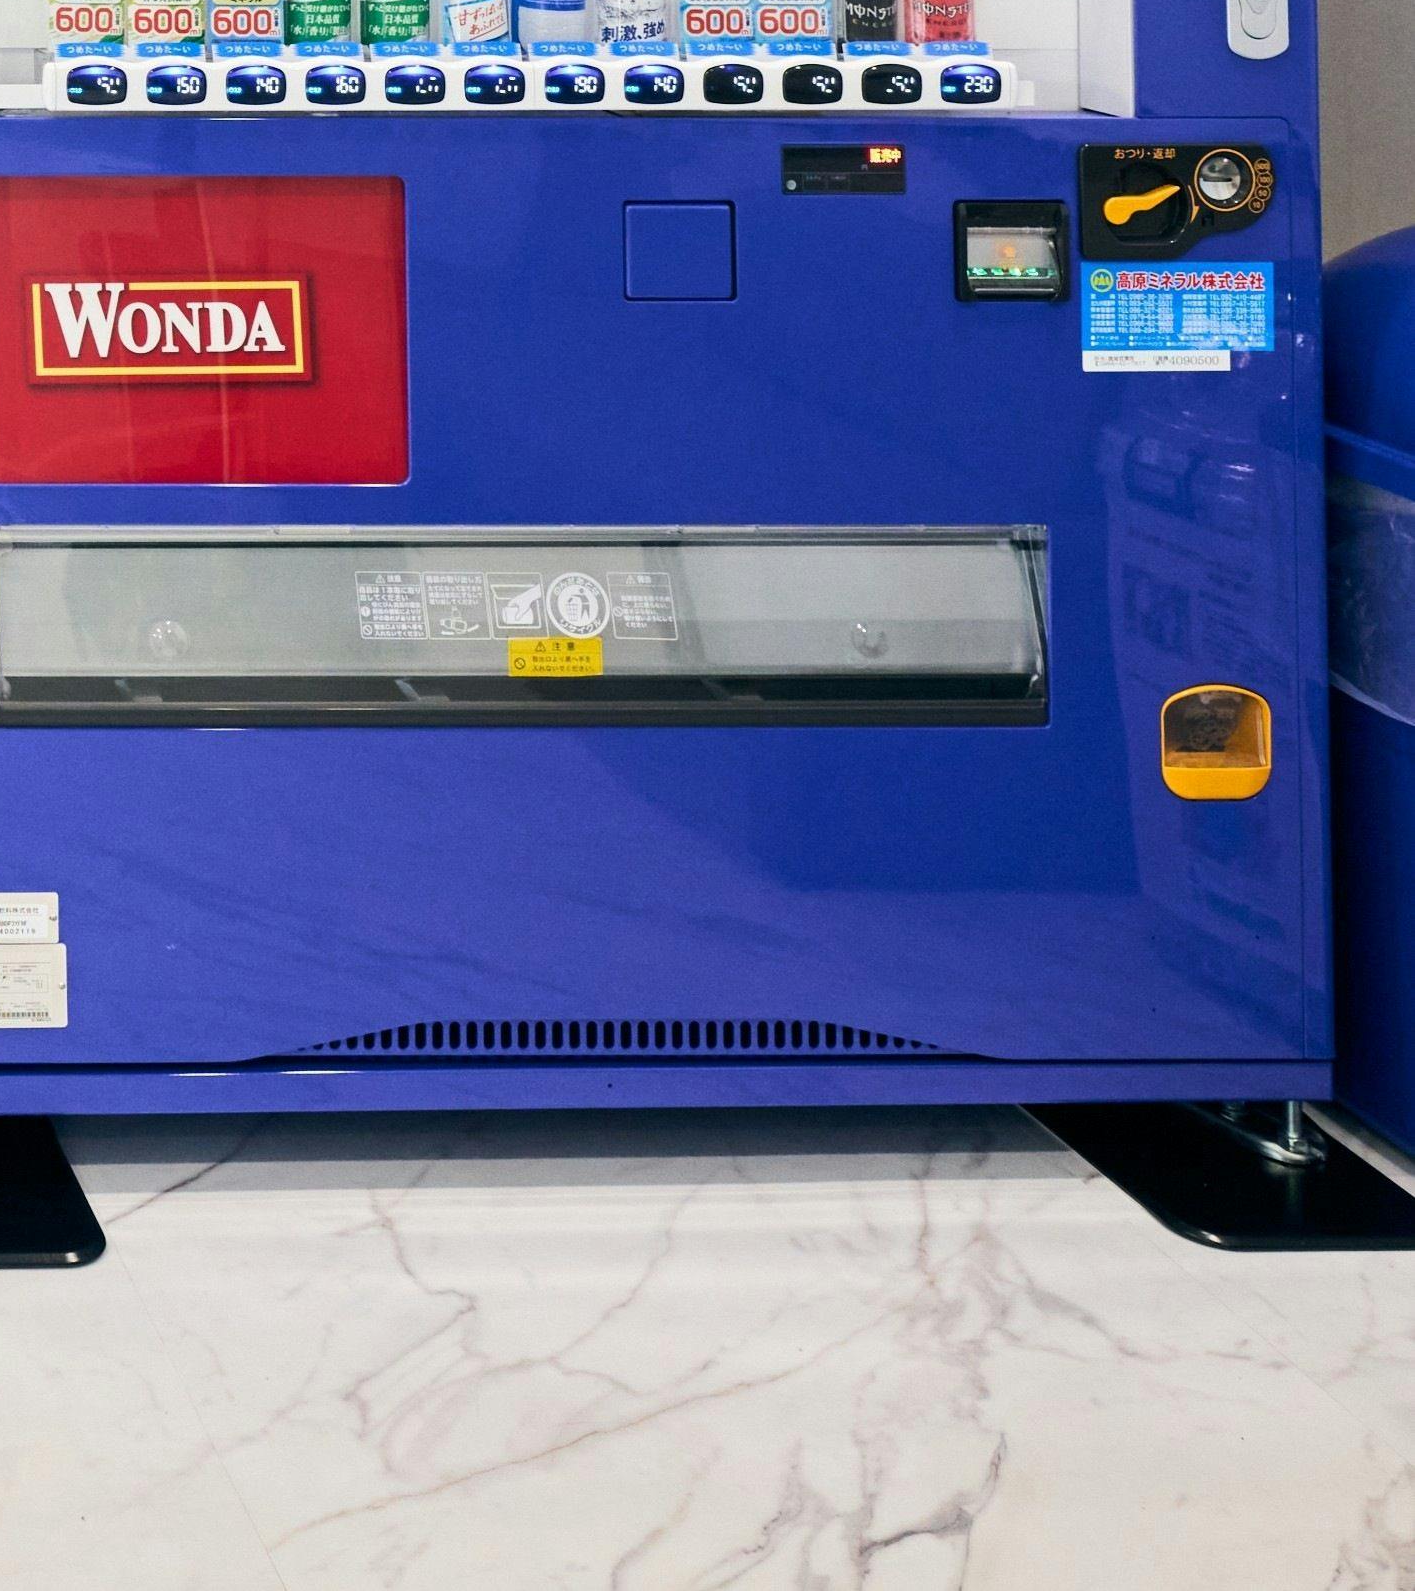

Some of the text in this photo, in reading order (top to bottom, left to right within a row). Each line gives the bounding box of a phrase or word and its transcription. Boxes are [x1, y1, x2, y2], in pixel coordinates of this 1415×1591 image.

[573, 76, 597, 93] 190
[964, 76, 993, 92] 230
[1115, 148, 1176, 160] おつり・返却
[1116, 272, 1265, 291] 高原ミネラル株式会社
[45, 283, 286, 359] WONDA
